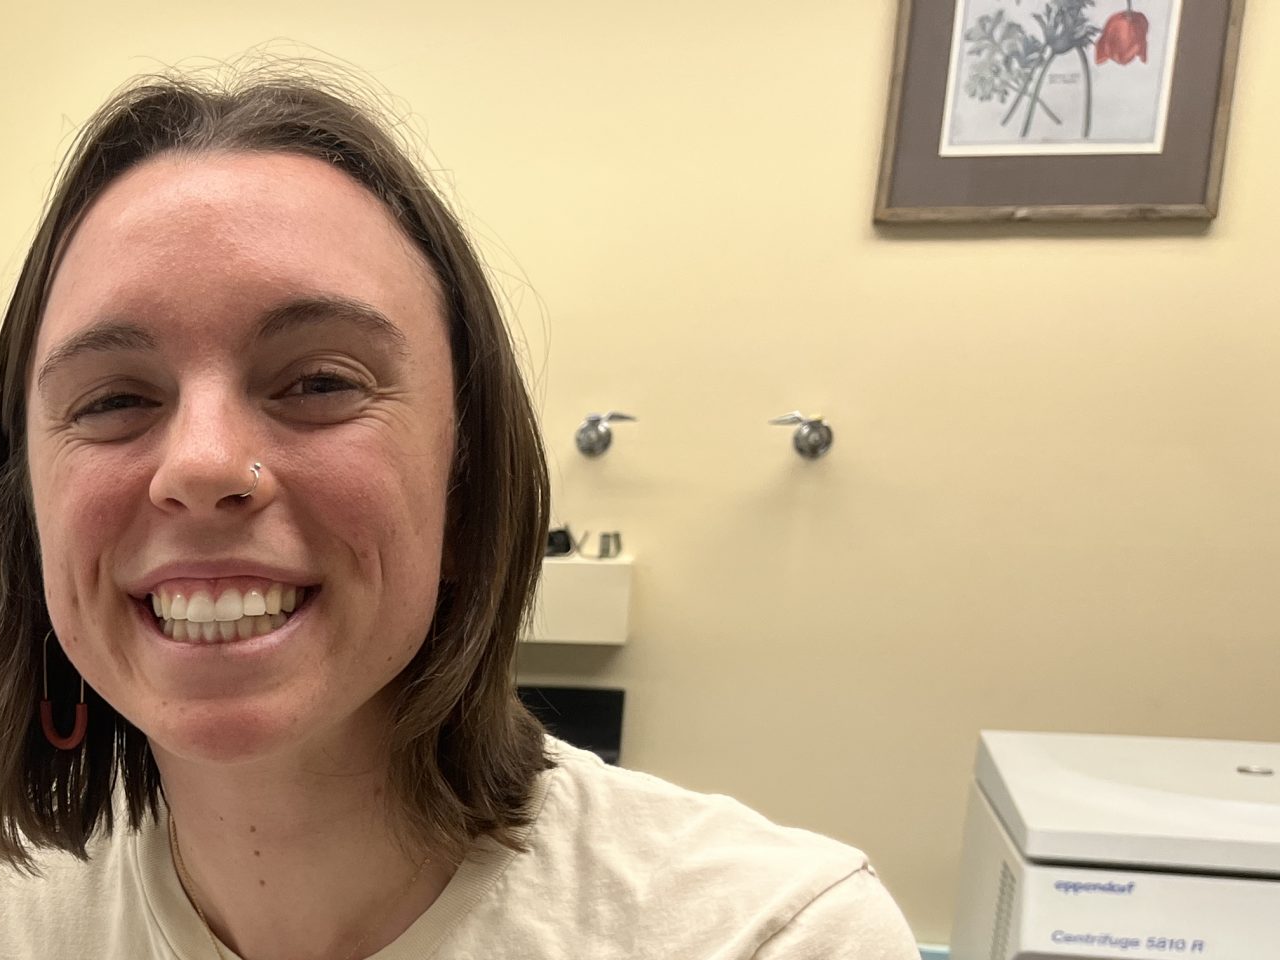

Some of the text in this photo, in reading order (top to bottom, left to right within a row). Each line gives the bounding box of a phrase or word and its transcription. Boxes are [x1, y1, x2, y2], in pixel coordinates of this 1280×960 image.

[1054, 880, 1135, 895] eppendorf
[1051, 930, 1204, 951] Centrifuge 5810 R
